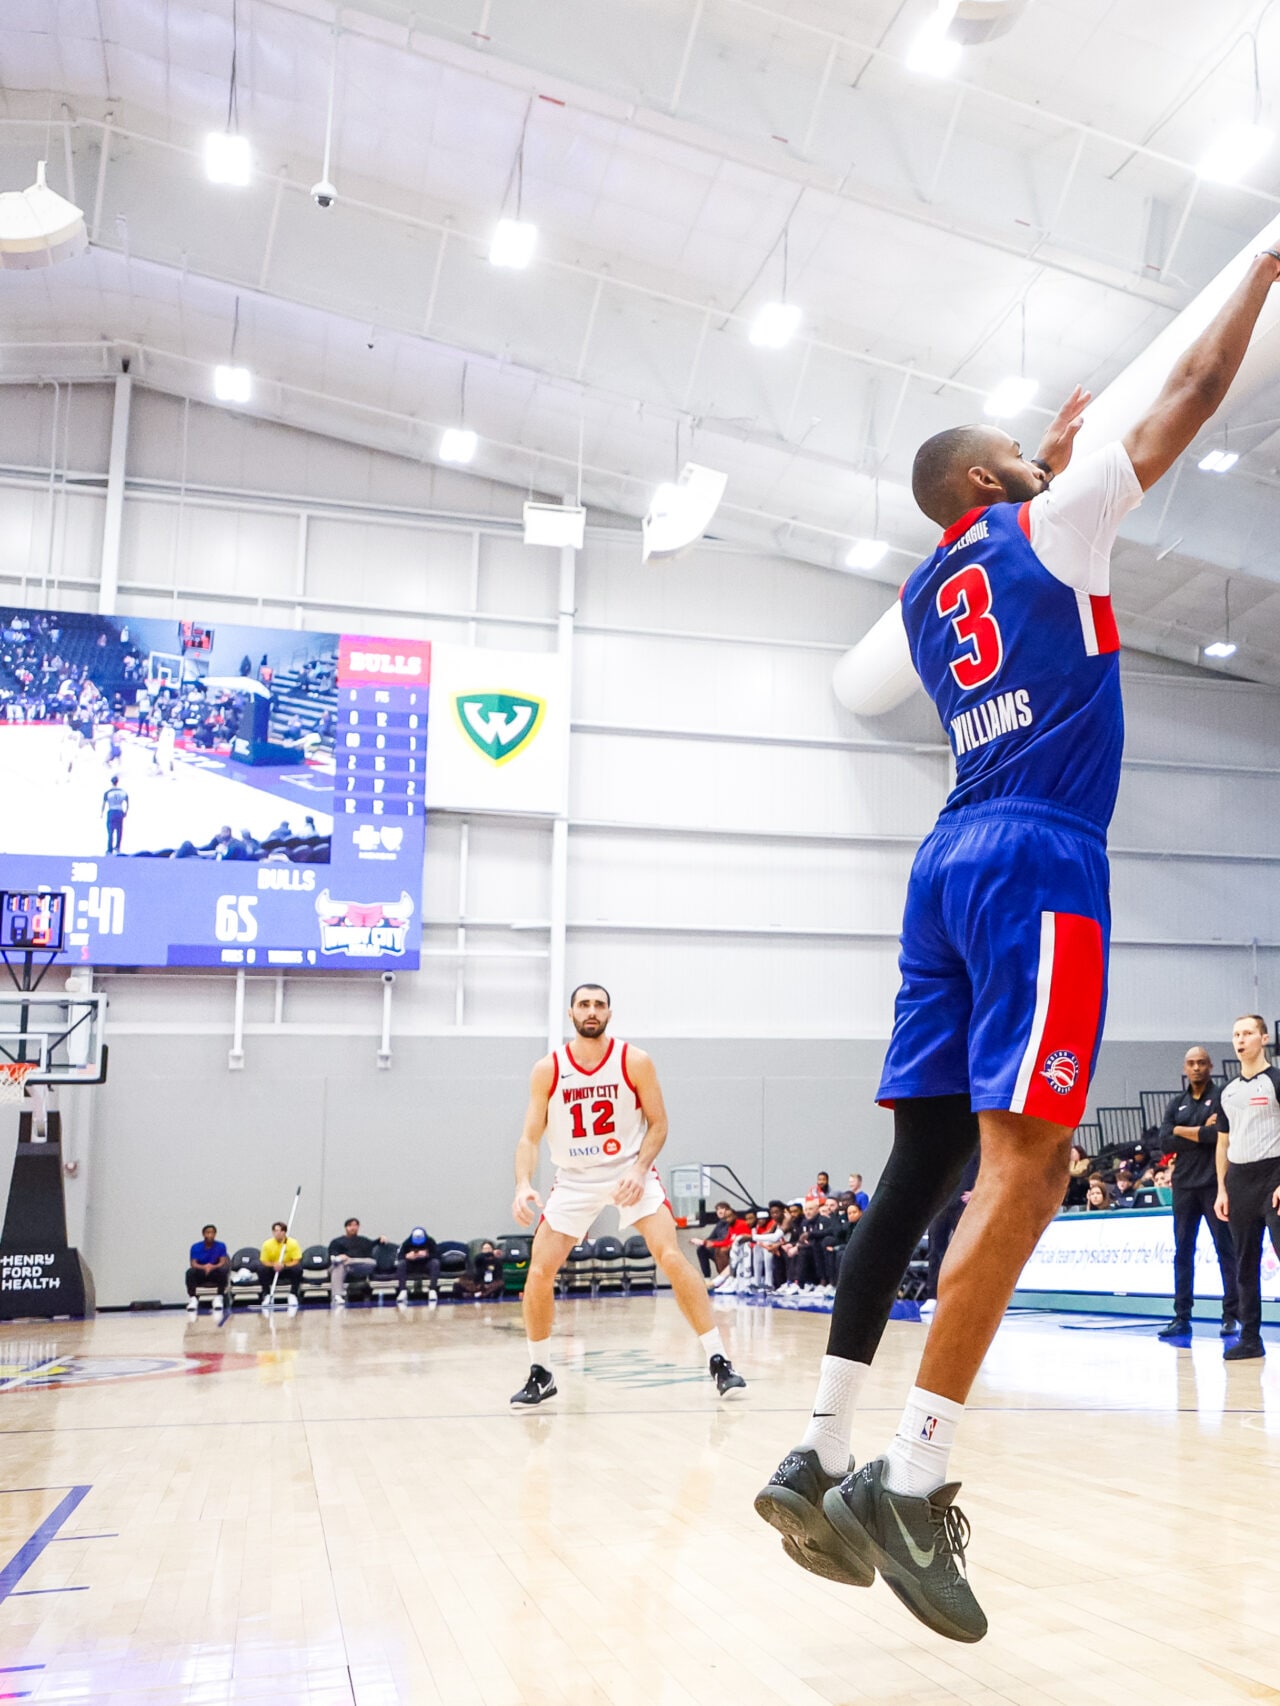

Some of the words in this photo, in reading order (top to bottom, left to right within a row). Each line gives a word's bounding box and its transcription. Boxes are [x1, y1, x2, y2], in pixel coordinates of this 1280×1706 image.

[936, 563, 1003, 690] 3
[349, 651, 422, 676] BULLS
[950, 689, 1033, 757] WILLIAMS
[215, 895, 259, 943] 65
[562, 1087, 595, 1104] WINDY
[596, 1084, 618, 1099] CITY
[570, 1100, 615, 1138] 12
[569, 1145, 600, 1157] BMO
[0, 1254, 55, 1266] HENRY
[2, 1266, 42, 1278] FORD
[1, 1277, 60, 1291] HEALTH
